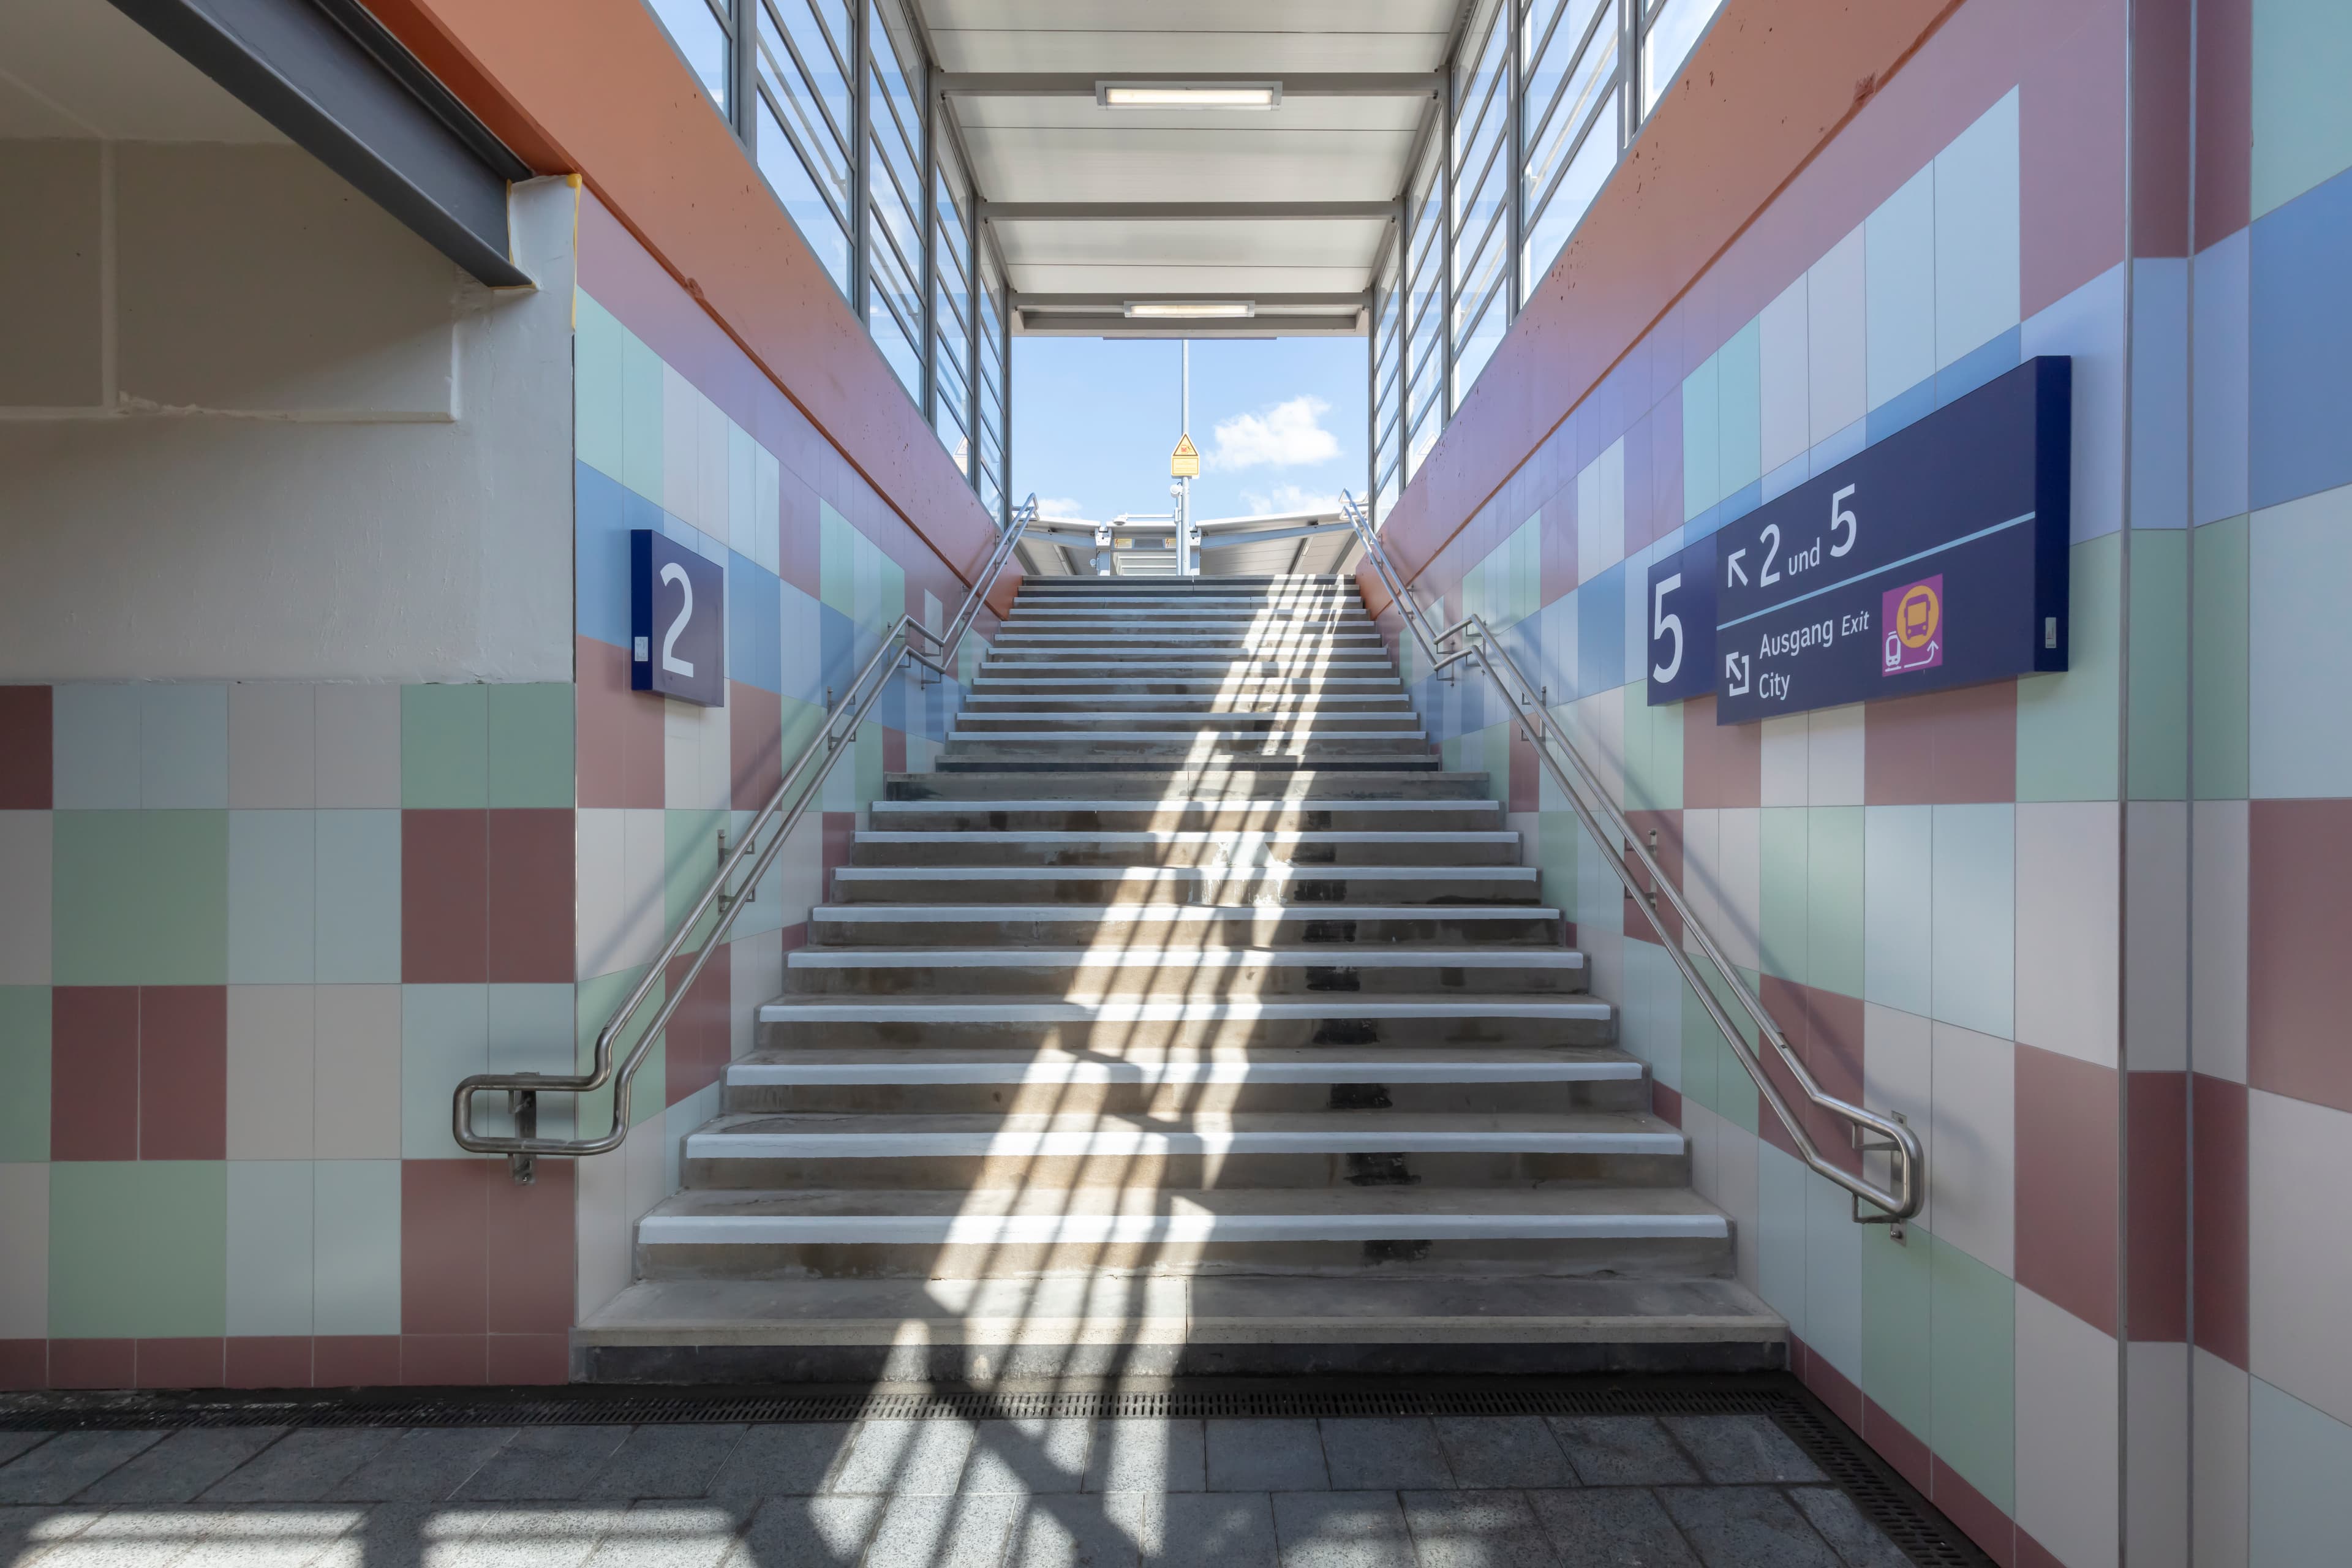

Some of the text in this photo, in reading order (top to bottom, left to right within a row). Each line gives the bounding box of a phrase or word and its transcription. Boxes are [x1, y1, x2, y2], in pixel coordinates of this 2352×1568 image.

[1760, 483, 1857, 588] 2 und 5
[660, 562, 695, 678] 2
[1653, 573, 1684, 684] 5
[1759, 611, 1869, 659] Ausgang Exit
[1759, 673, 1791, 701] City
